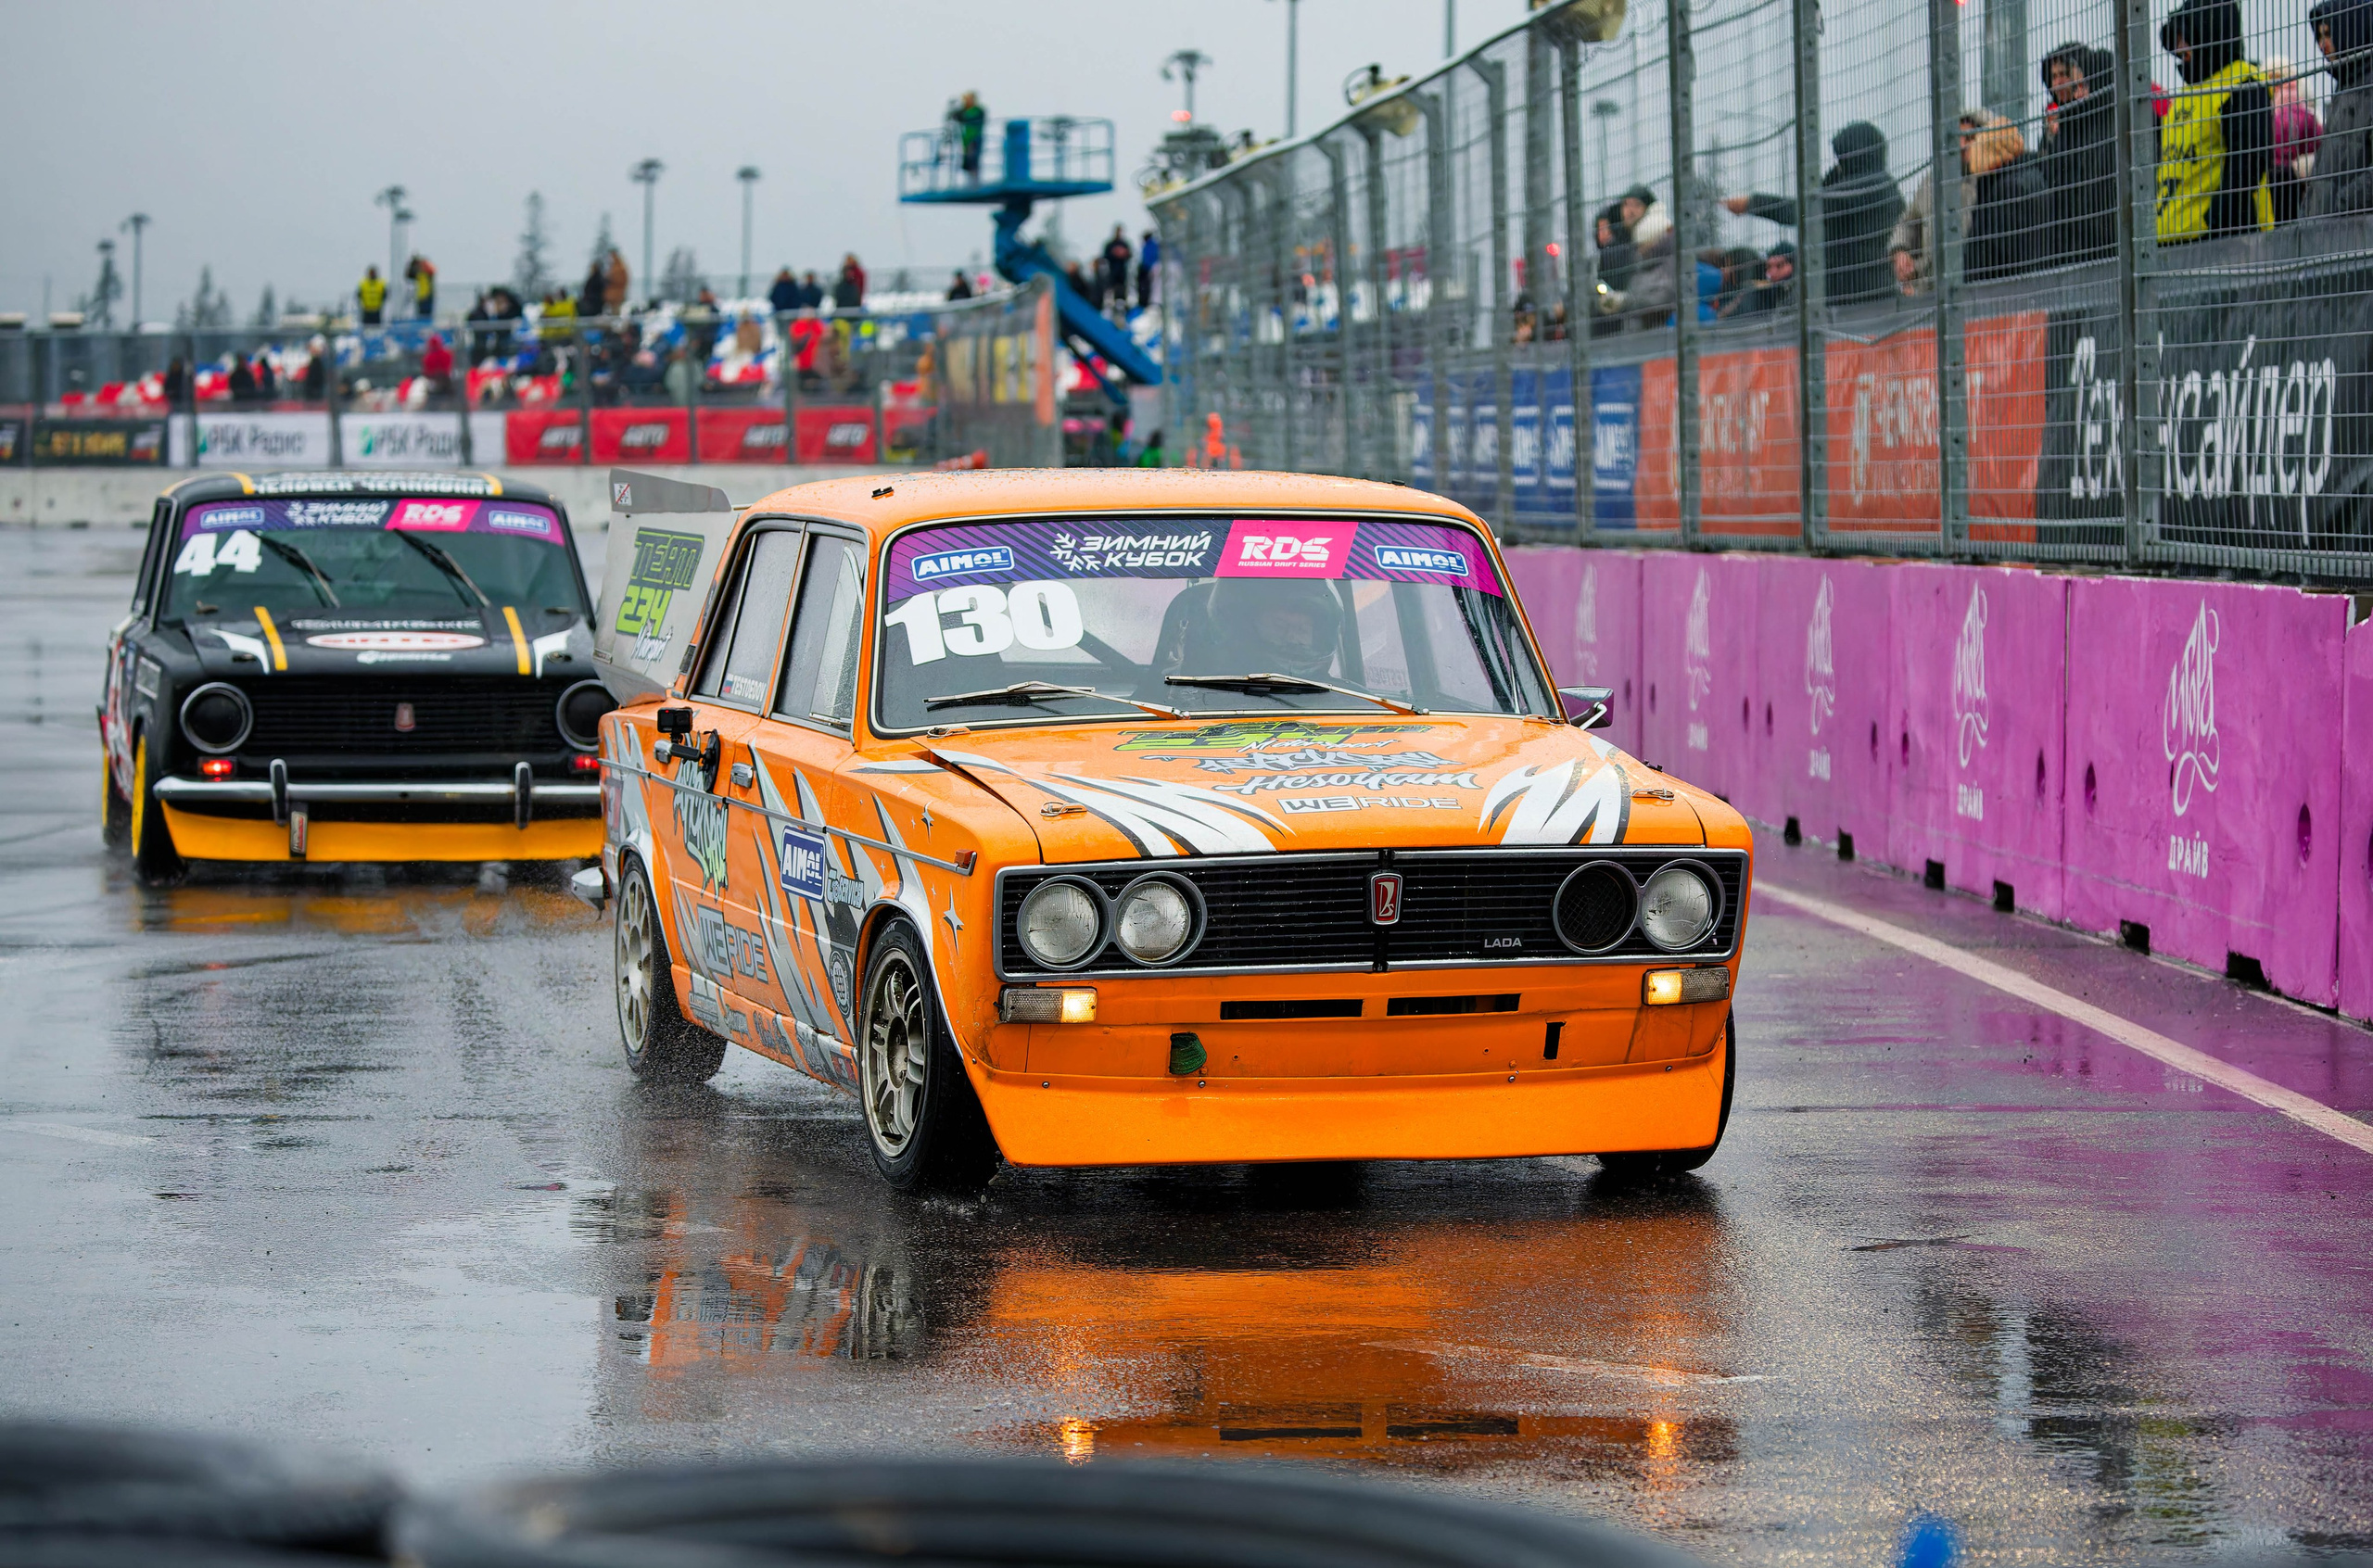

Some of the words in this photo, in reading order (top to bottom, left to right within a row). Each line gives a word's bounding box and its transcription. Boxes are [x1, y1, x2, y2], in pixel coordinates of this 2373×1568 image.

[404, 504, 463, 521] RDS
[173, 529, 262, 576] 44
[1080, 531, 1212, 551] ЗИМНИЙ
[1241, 536, 1333, 560] RDS
[631, 526, 704, 590] TEAM
[918, 550, 1009, 576] AIMOL
[1104, 551, 1206, 567] КУБОК
[1382, 550, 1464, 571] AIMOL
[615, 585, 673, 638] 234
[884, 580, 1084, 665] 130
[1212, 772, 1484, 794] Hesoyam
[782, 843, 822, 886] AIMOL
[2168, 831, 2208, 878] ДРАЙВ
[1484, 938, 1522, 948] LADA
